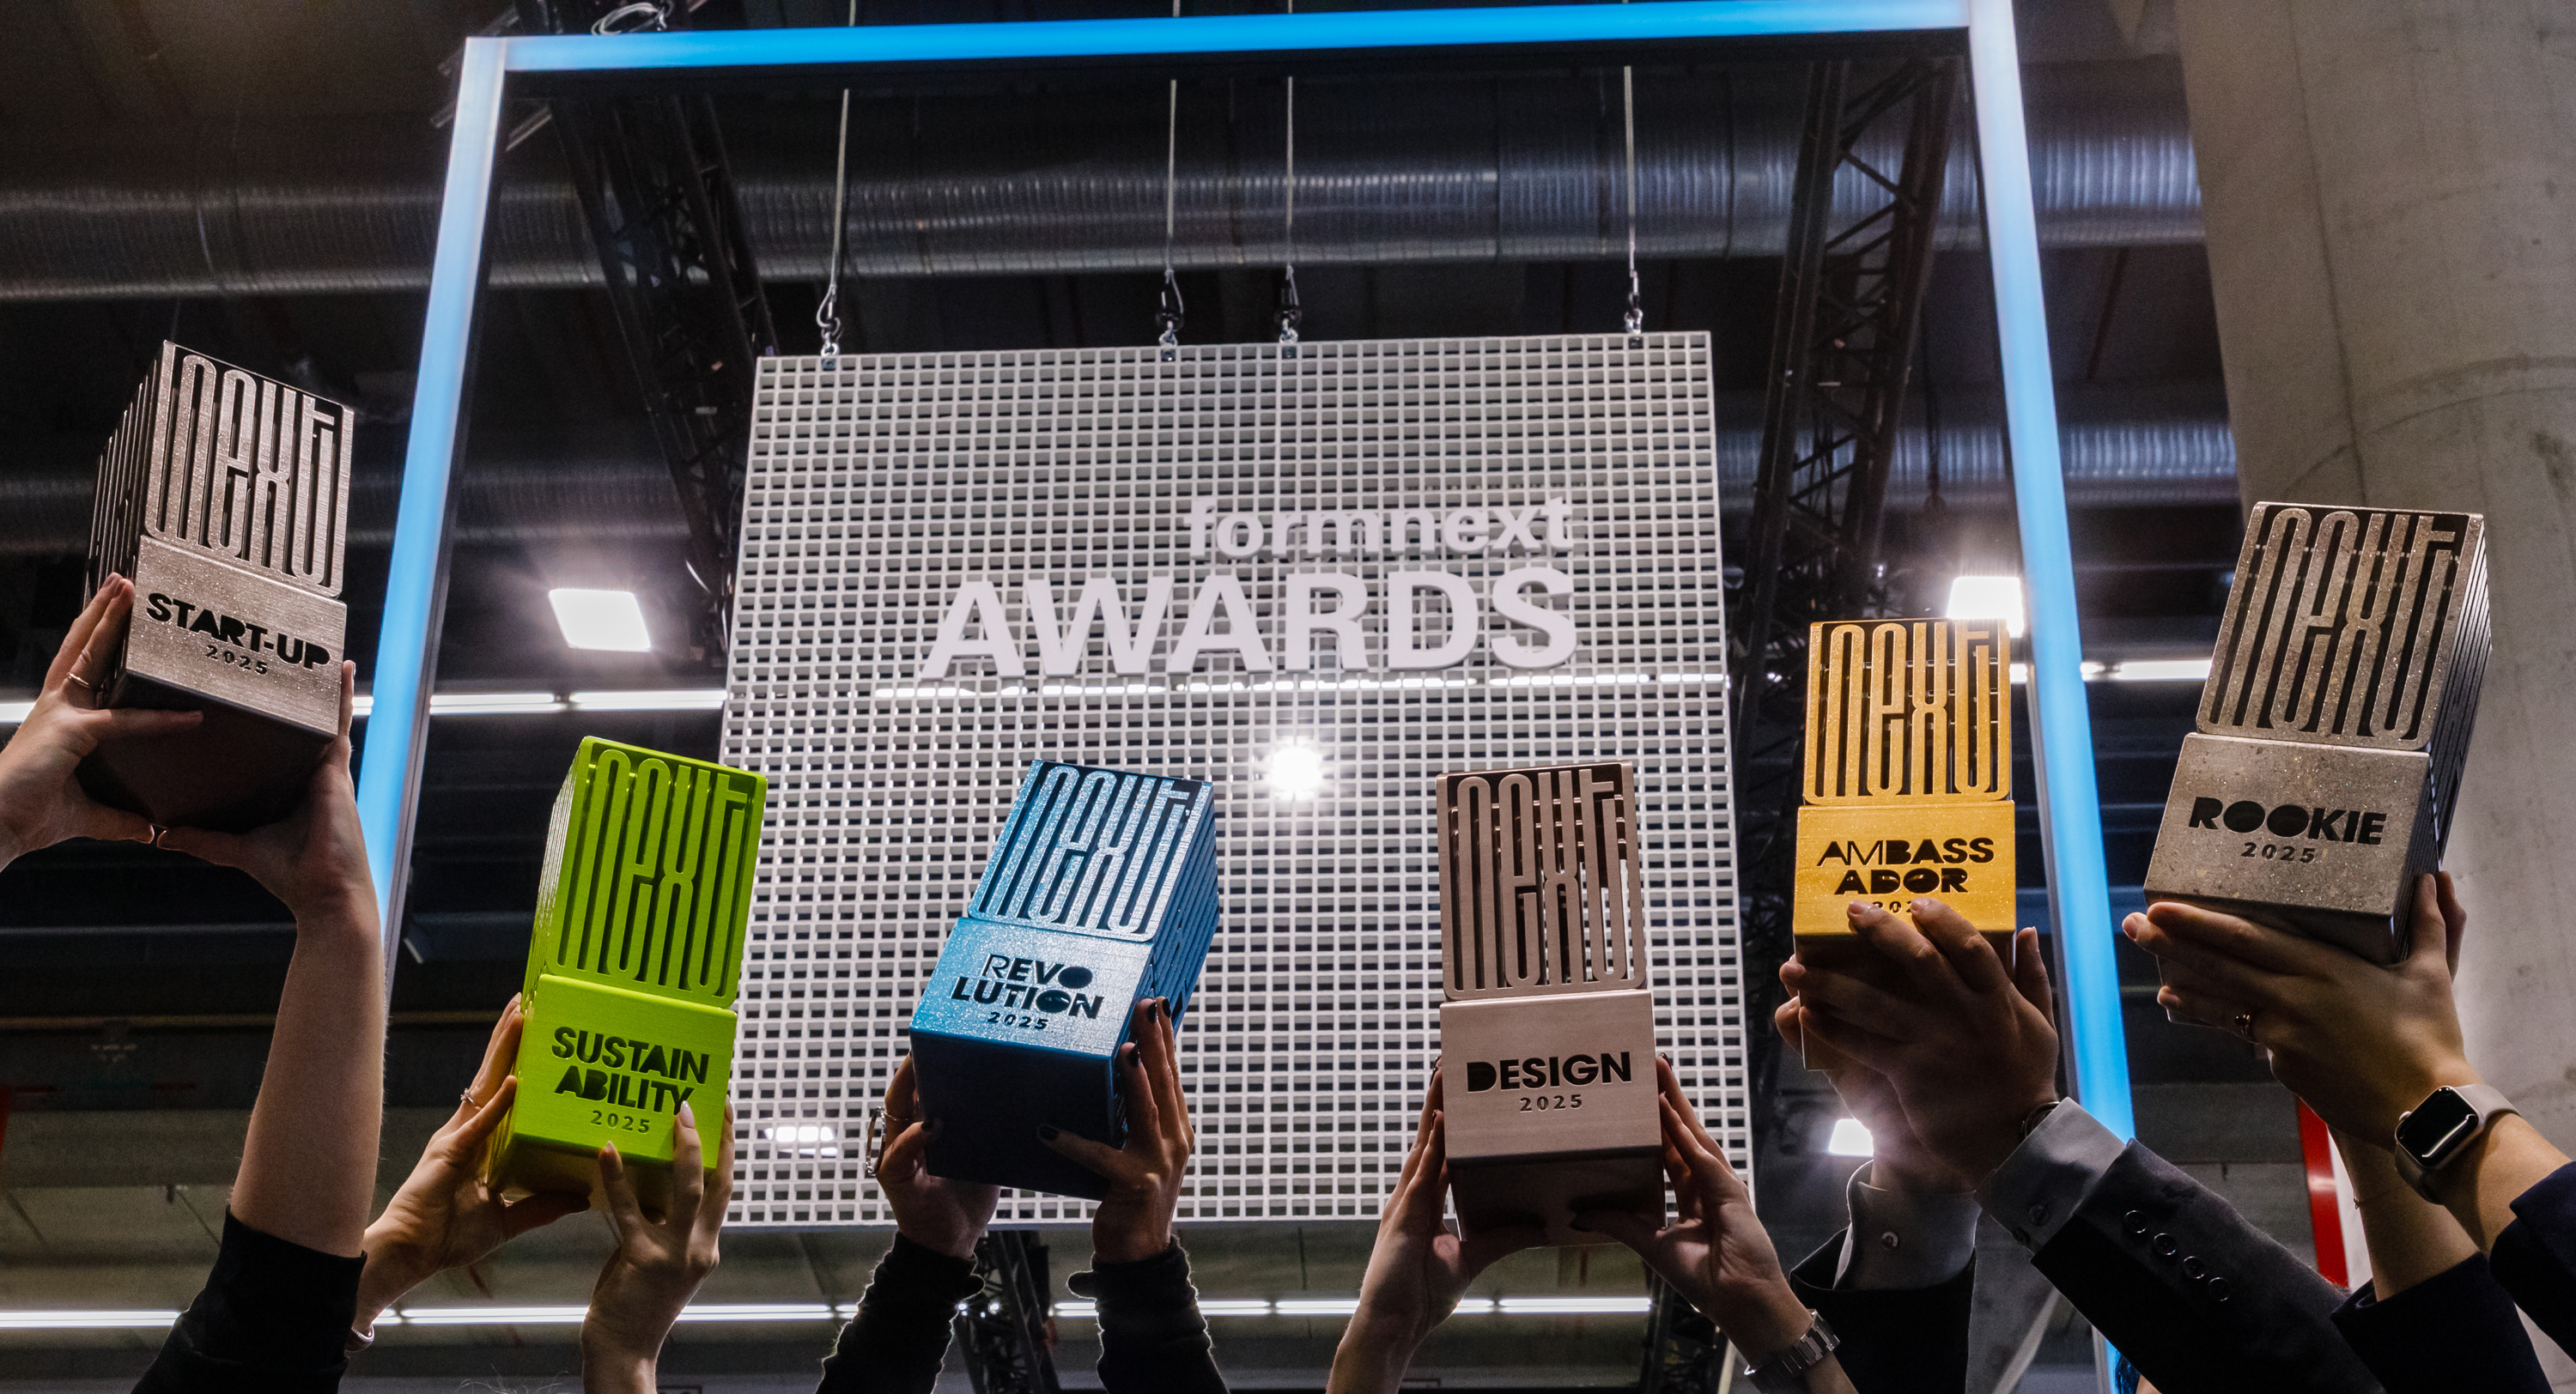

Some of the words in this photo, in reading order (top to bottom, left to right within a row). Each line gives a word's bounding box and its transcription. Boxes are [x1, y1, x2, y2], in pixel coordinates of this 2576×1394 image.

[1183, 496, 1577, 561] formnext
[146, 592, 331, 670] START-UP
[919, 567, 1579, 682] AWARDS
[205, 645, 269, 675] 2025
[2188, 797, 2387, 845] ROOKIE
[1816, 837, 1995, 867] AMBASS
[2241, 842, 2318, 864] 2025
[1834, 868, 1968, 894] ADOR
[1872, 900, 1912, 913] 20
[981, 953, 1093, 989] REVO
[951, 977, 1104, 1019] LUTION
[987, 1011, 1048, 1030] 2025
[551, 1026, 709, 1085] SUSTAIN
[1466, 1052, 1632, 1094] DESIGN
[554, 1065, 696, 1116] ABILITY
[1519, 1094, 1583, 1112] 2025
[590, 1109, 651, 1134] 2025
